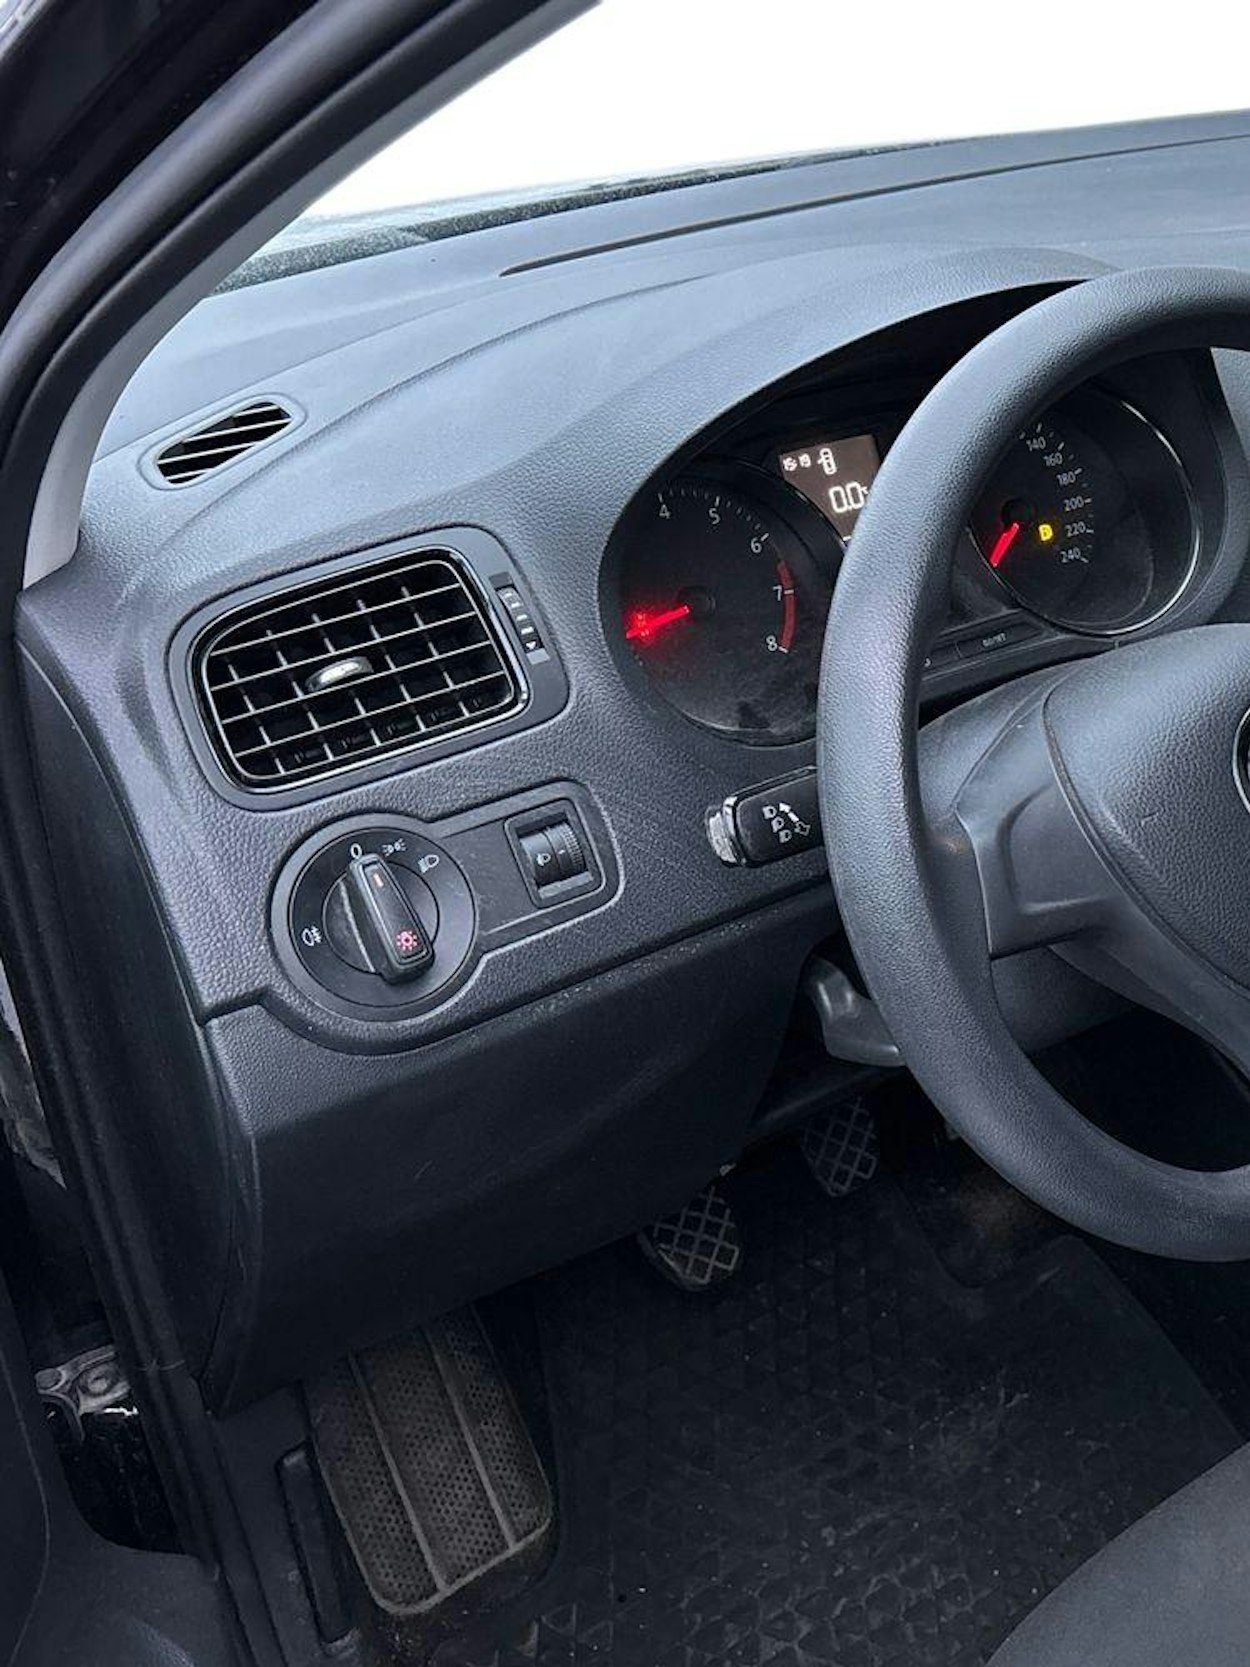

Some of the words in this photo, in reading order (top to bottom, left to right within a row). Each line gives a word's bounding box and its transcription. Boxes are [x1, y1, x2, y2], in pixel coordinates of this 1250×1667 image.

[1026, 436, 1046, 451] 140
[1043, 453, 1063, 467] 160
[1056, 471, 1076, 485] 180
[1064, 496, 1084, 511] 200
[659, 504, 670, 519] 4
[709, 509, 720, 524] 5
[1066, 522, 1086, 537] 220
[751, 537, 762, 552] 6
[1061, 548, 1081, 562] 240
[773, 585, 781, 601] 7
[766, 635, 777, 651] 8
